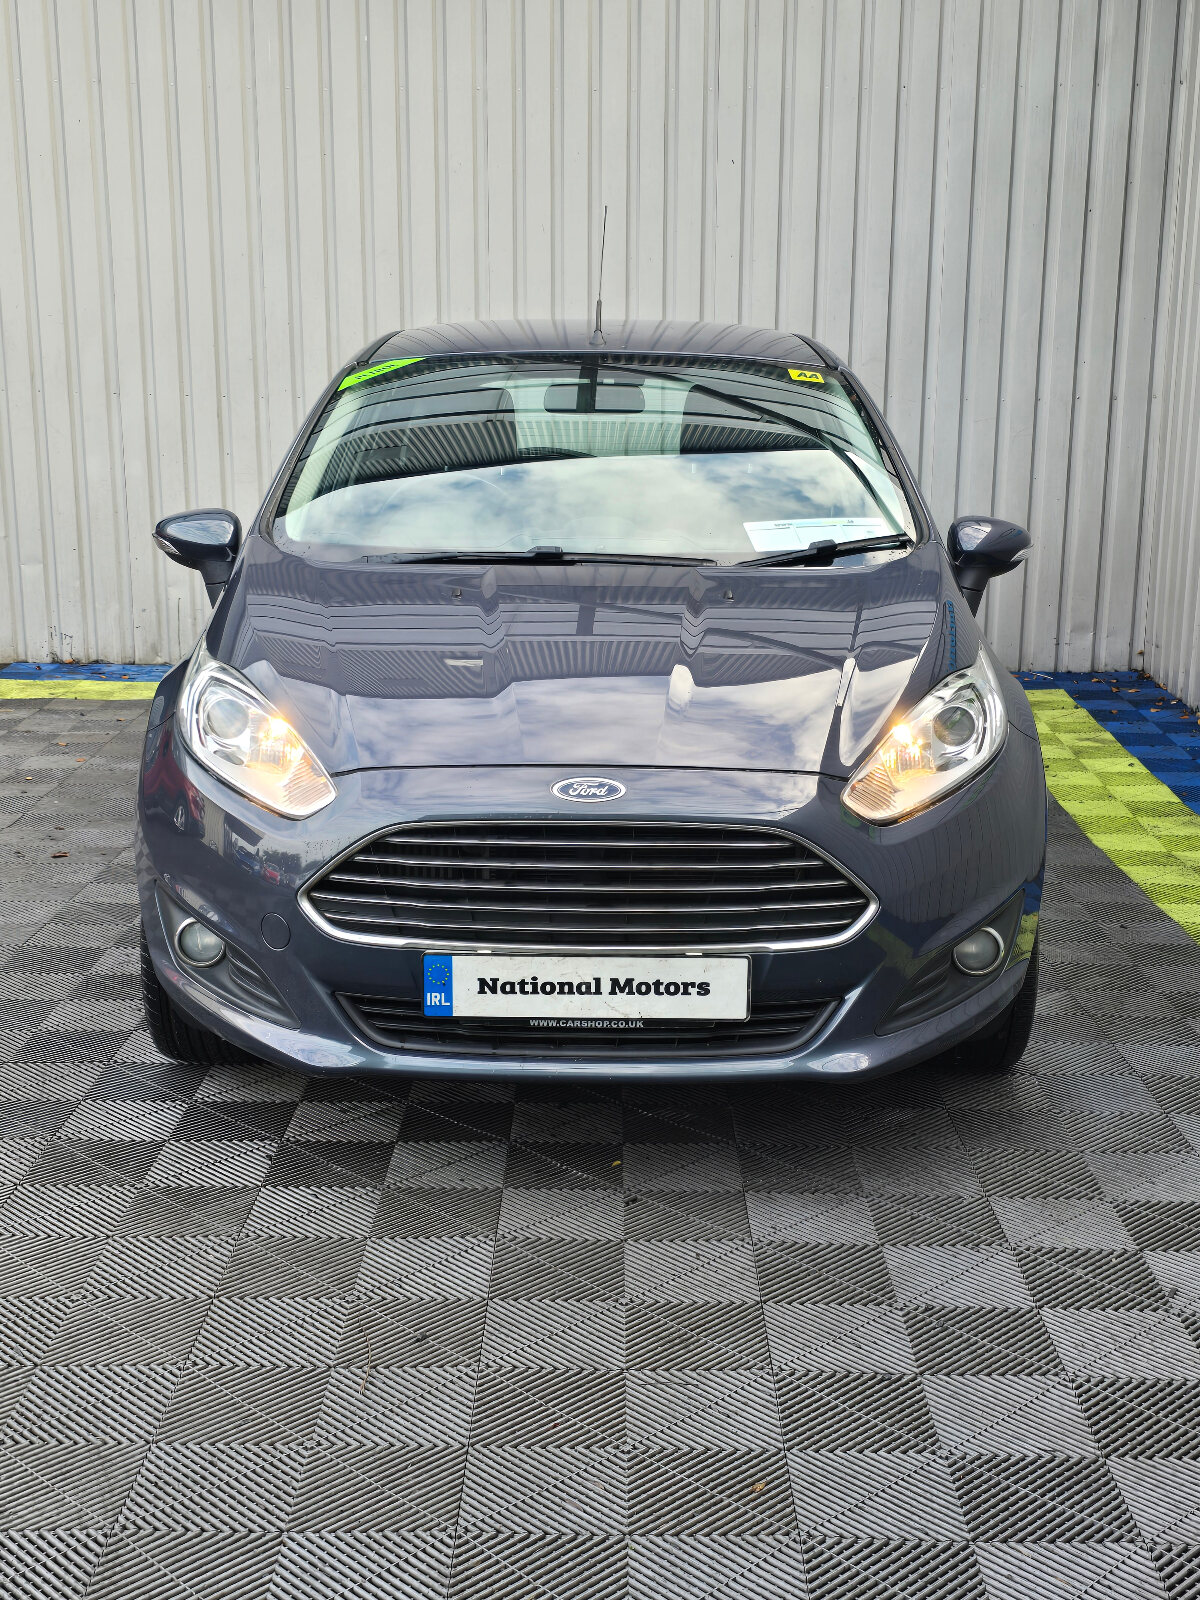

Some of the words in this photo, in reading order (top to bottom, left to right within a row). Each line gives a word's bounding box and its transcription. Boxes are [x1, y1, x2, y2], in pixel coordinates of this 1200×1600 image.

[797, 371, 820, 380] AA
[568, 782, 609, 796] Ford
[477, 976, 603, 996] National
[608, 977, 711, 996] Motors
[426, 992, 451, 1006] IRL
[529, 1019, 644, 1028] WWW.CARSHOP.CO.UK
